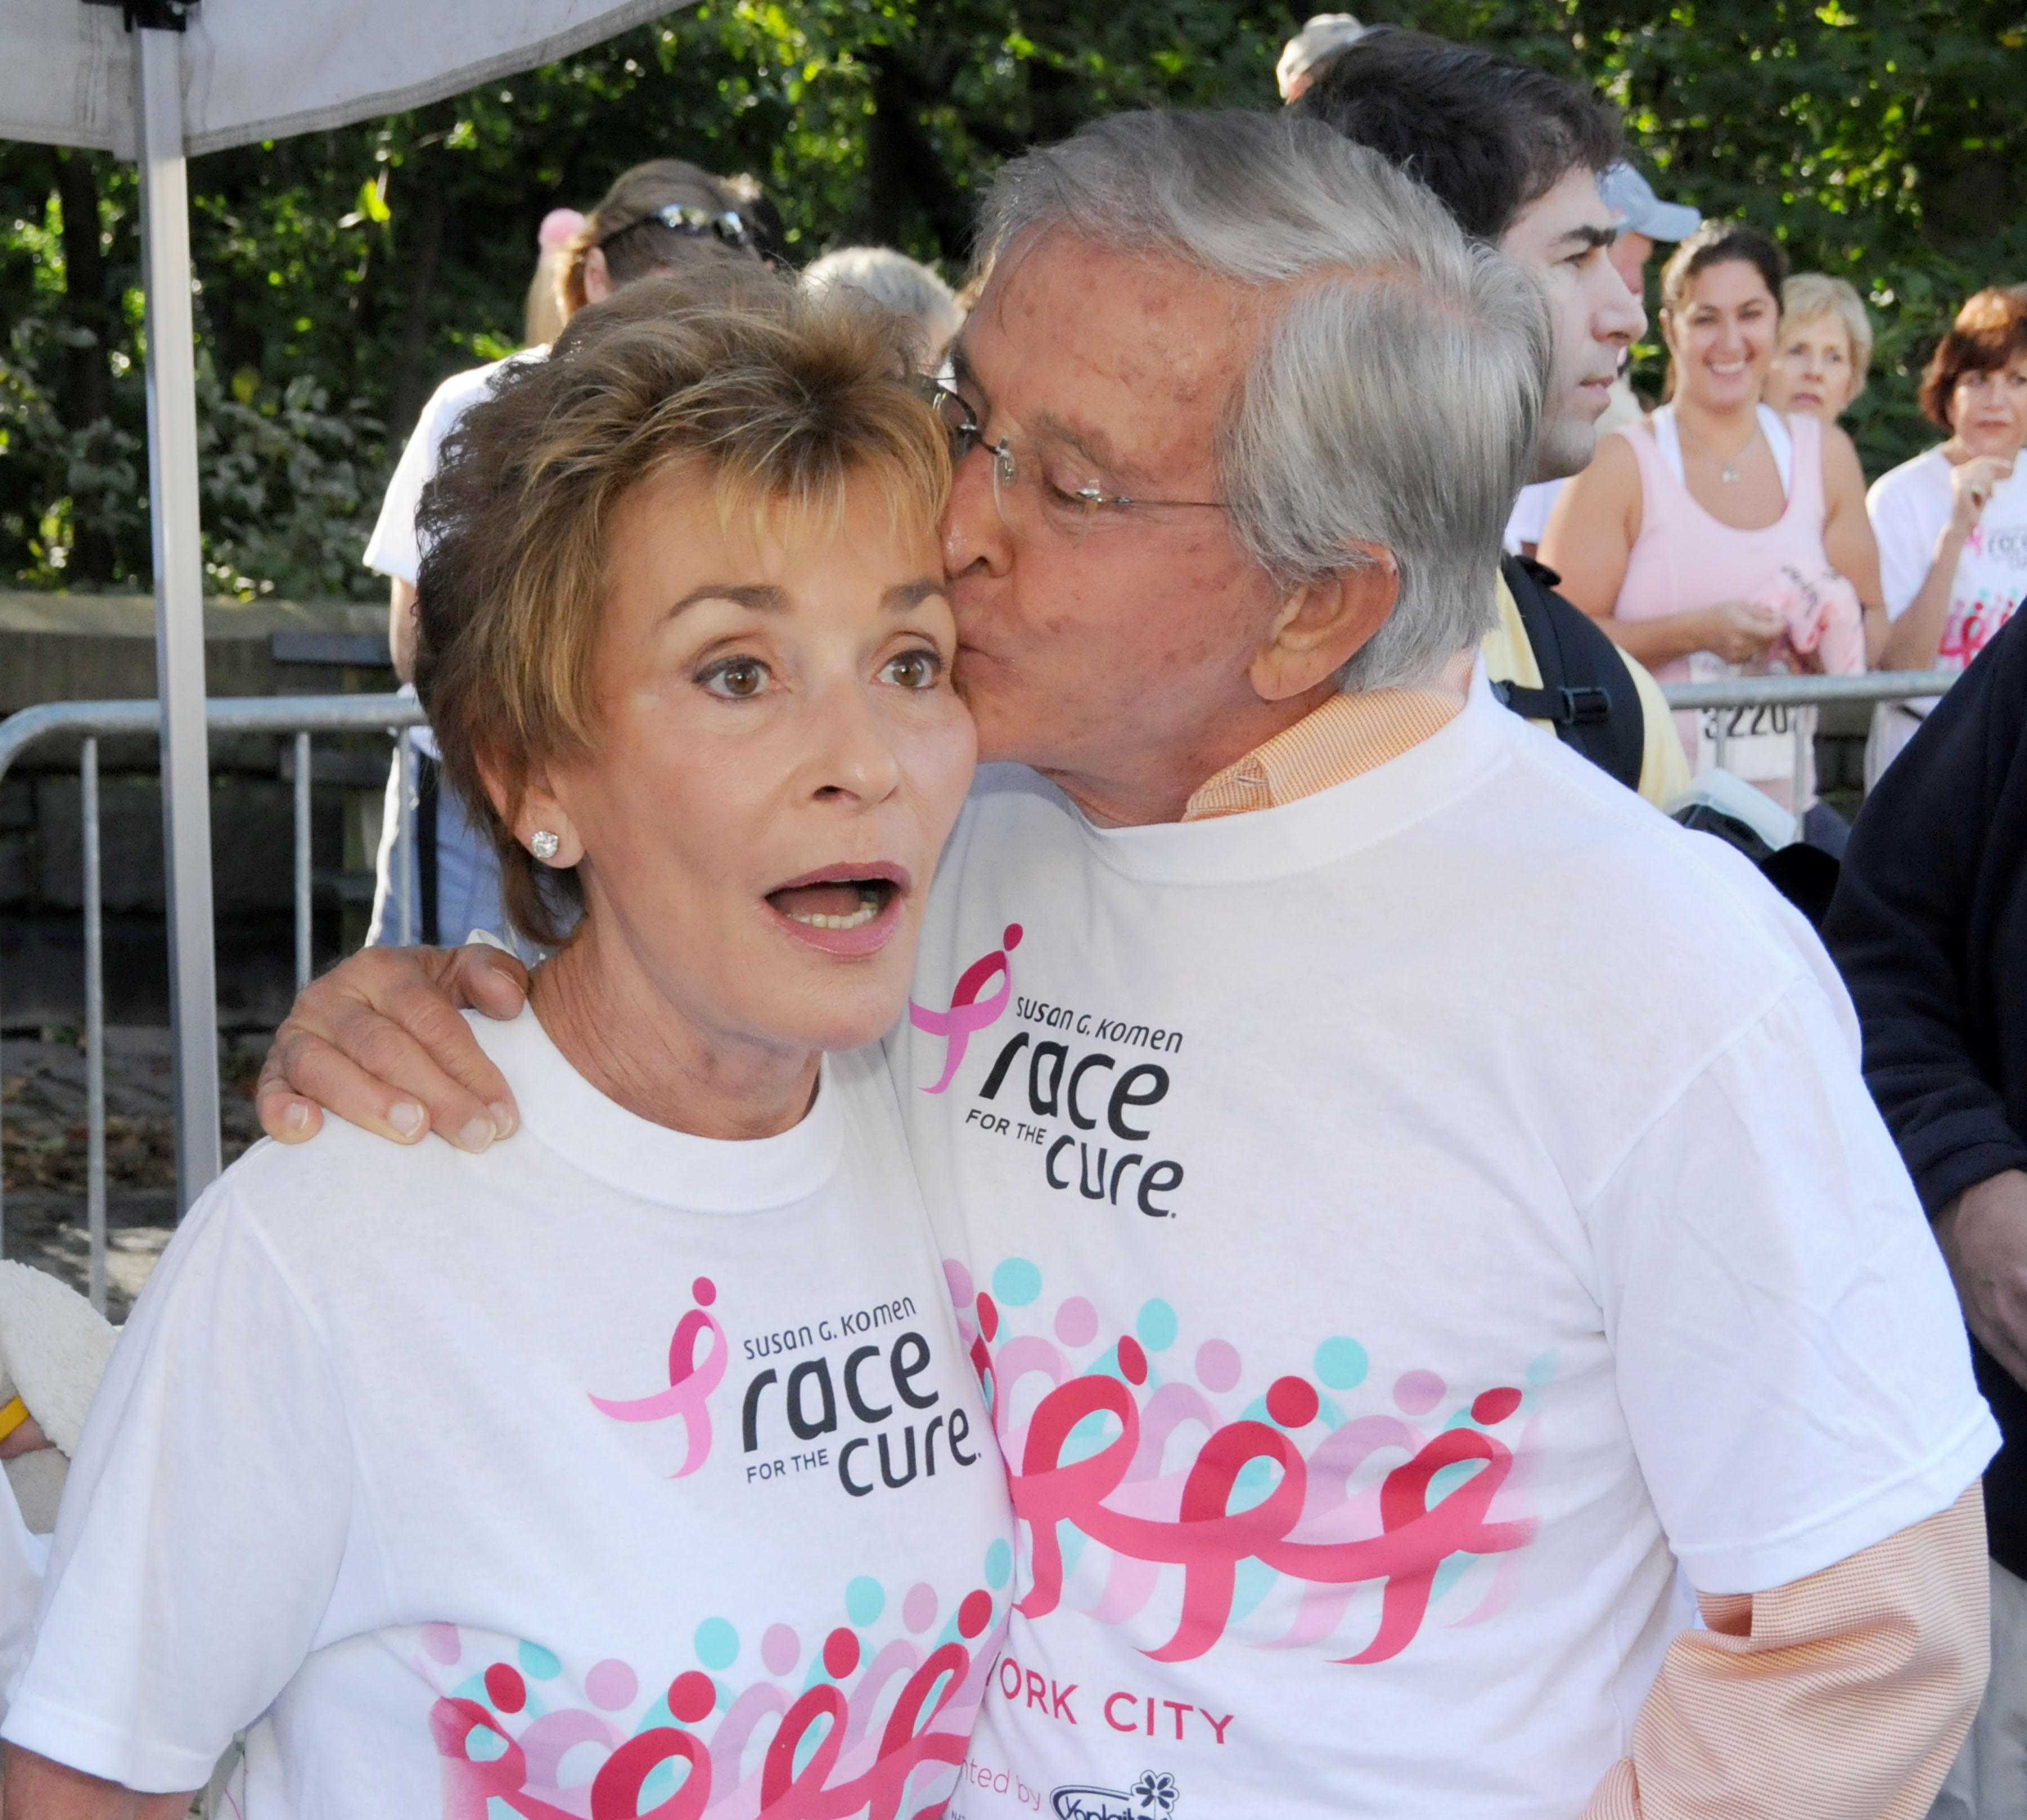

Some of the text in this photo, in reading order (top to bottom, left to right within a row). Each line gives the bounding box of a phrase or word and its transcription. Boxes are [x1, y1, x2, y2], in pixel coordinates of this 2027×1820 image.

[978, 1031, 1170, 1142] race
[965, 1108, 1047, 1146] FOR THE
[742, 1331, 939, 1454] race
[746, 1448, 830, 1484] FOR THE
[1000, 1657, 1234, 1745] ORK CITY
[1016, 1775, 1041, 1812] by
